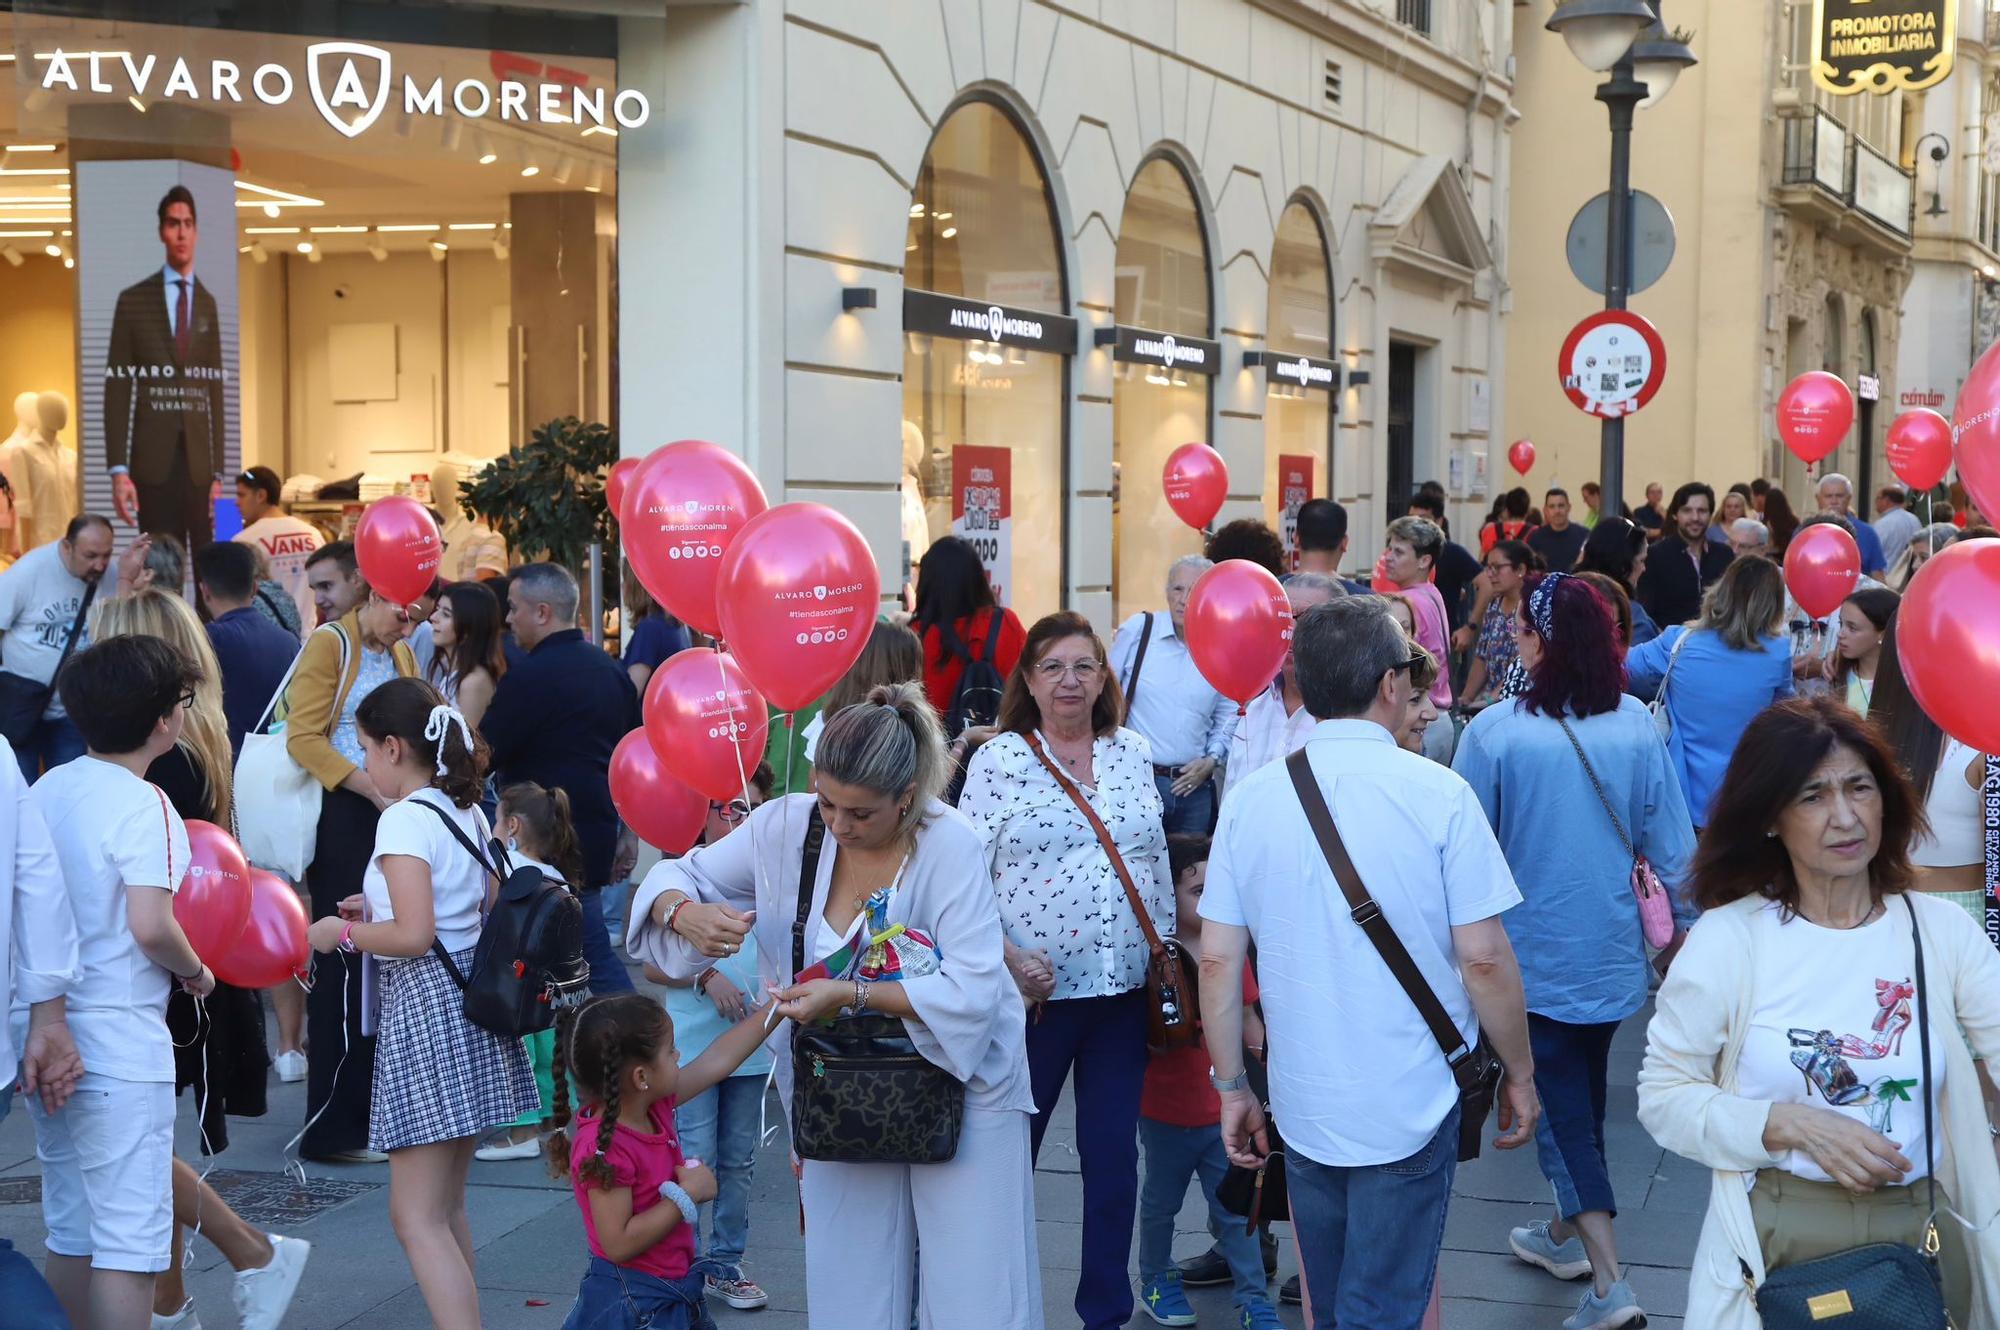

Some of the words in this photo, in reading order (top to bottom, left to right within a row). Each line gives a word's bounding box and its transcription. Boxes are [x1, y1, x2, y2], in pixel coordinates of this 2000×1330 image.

[1831, 11, 1937, 37] PROMOTORA
[1830, 31, 1936, 57] INMOBILIARIA
[42, 47, 293, 105] ALVARO
[330, 57, 370, 109] A
[404, 73, 650, 129] MORENO
[950, 308, 989, 331] ALVARO
[1003, 317, 1043, 340] MORENO
[1134, 338, 1164, 358] ALVARO
[1174, 345, 1205, 364] MORENO
[105, 364, 176, 379] ALVARO
[184, 366, 229, 380] MORENO
[648, 504, 683, 514] ALVARO
[660, 522, 728, 533] #tiendasconalma
[259, 532, 316, 556] VANS
[774, 591, 813, 600] ALVARO
[828, 583, 863, 597] MORENO
[789, 605, 854, 619] #tiendasconalma
[205, 869, 239, 880] MORENO
